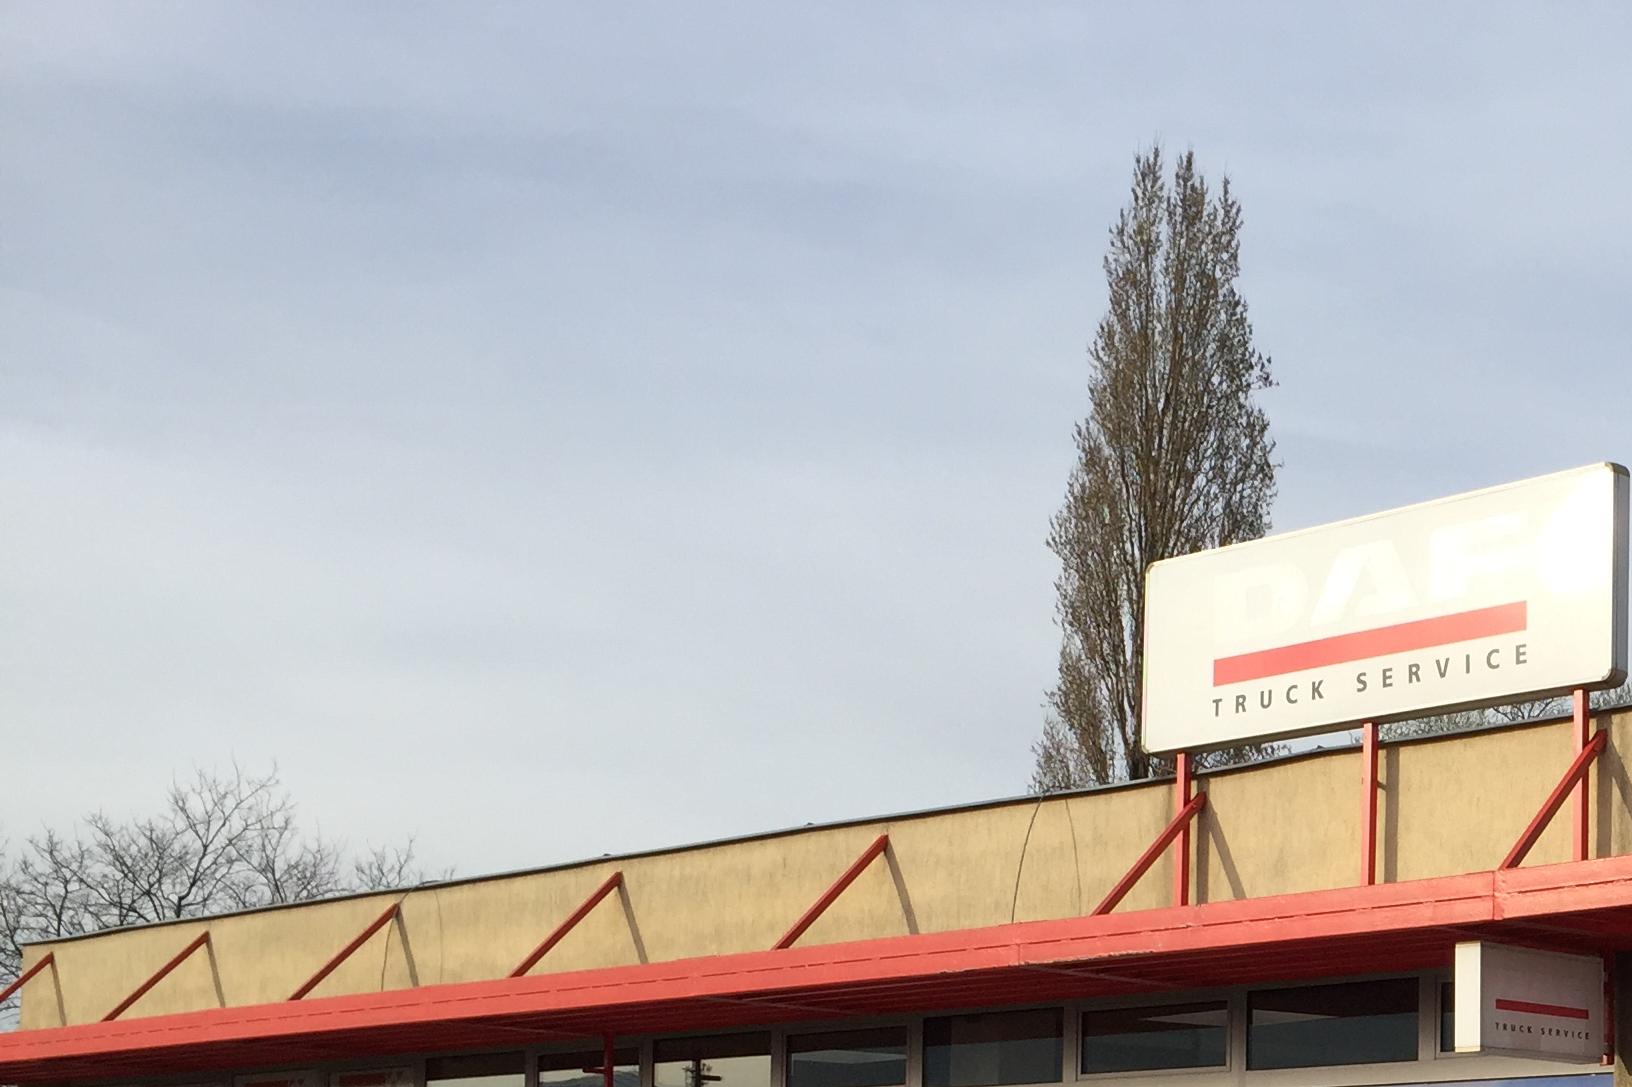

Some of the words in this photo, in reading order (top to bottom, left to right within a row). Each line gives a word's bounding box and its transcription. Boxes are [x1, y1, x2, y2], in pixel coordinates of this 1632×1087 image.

[1212, 679, 1327, 718] TRUCK
[1356, 643, 1530, 693] SERVICE
[1495, 1022, 1534, 1034] TRUCK
[1540, 1026, 1591, 1040] SERVICE
